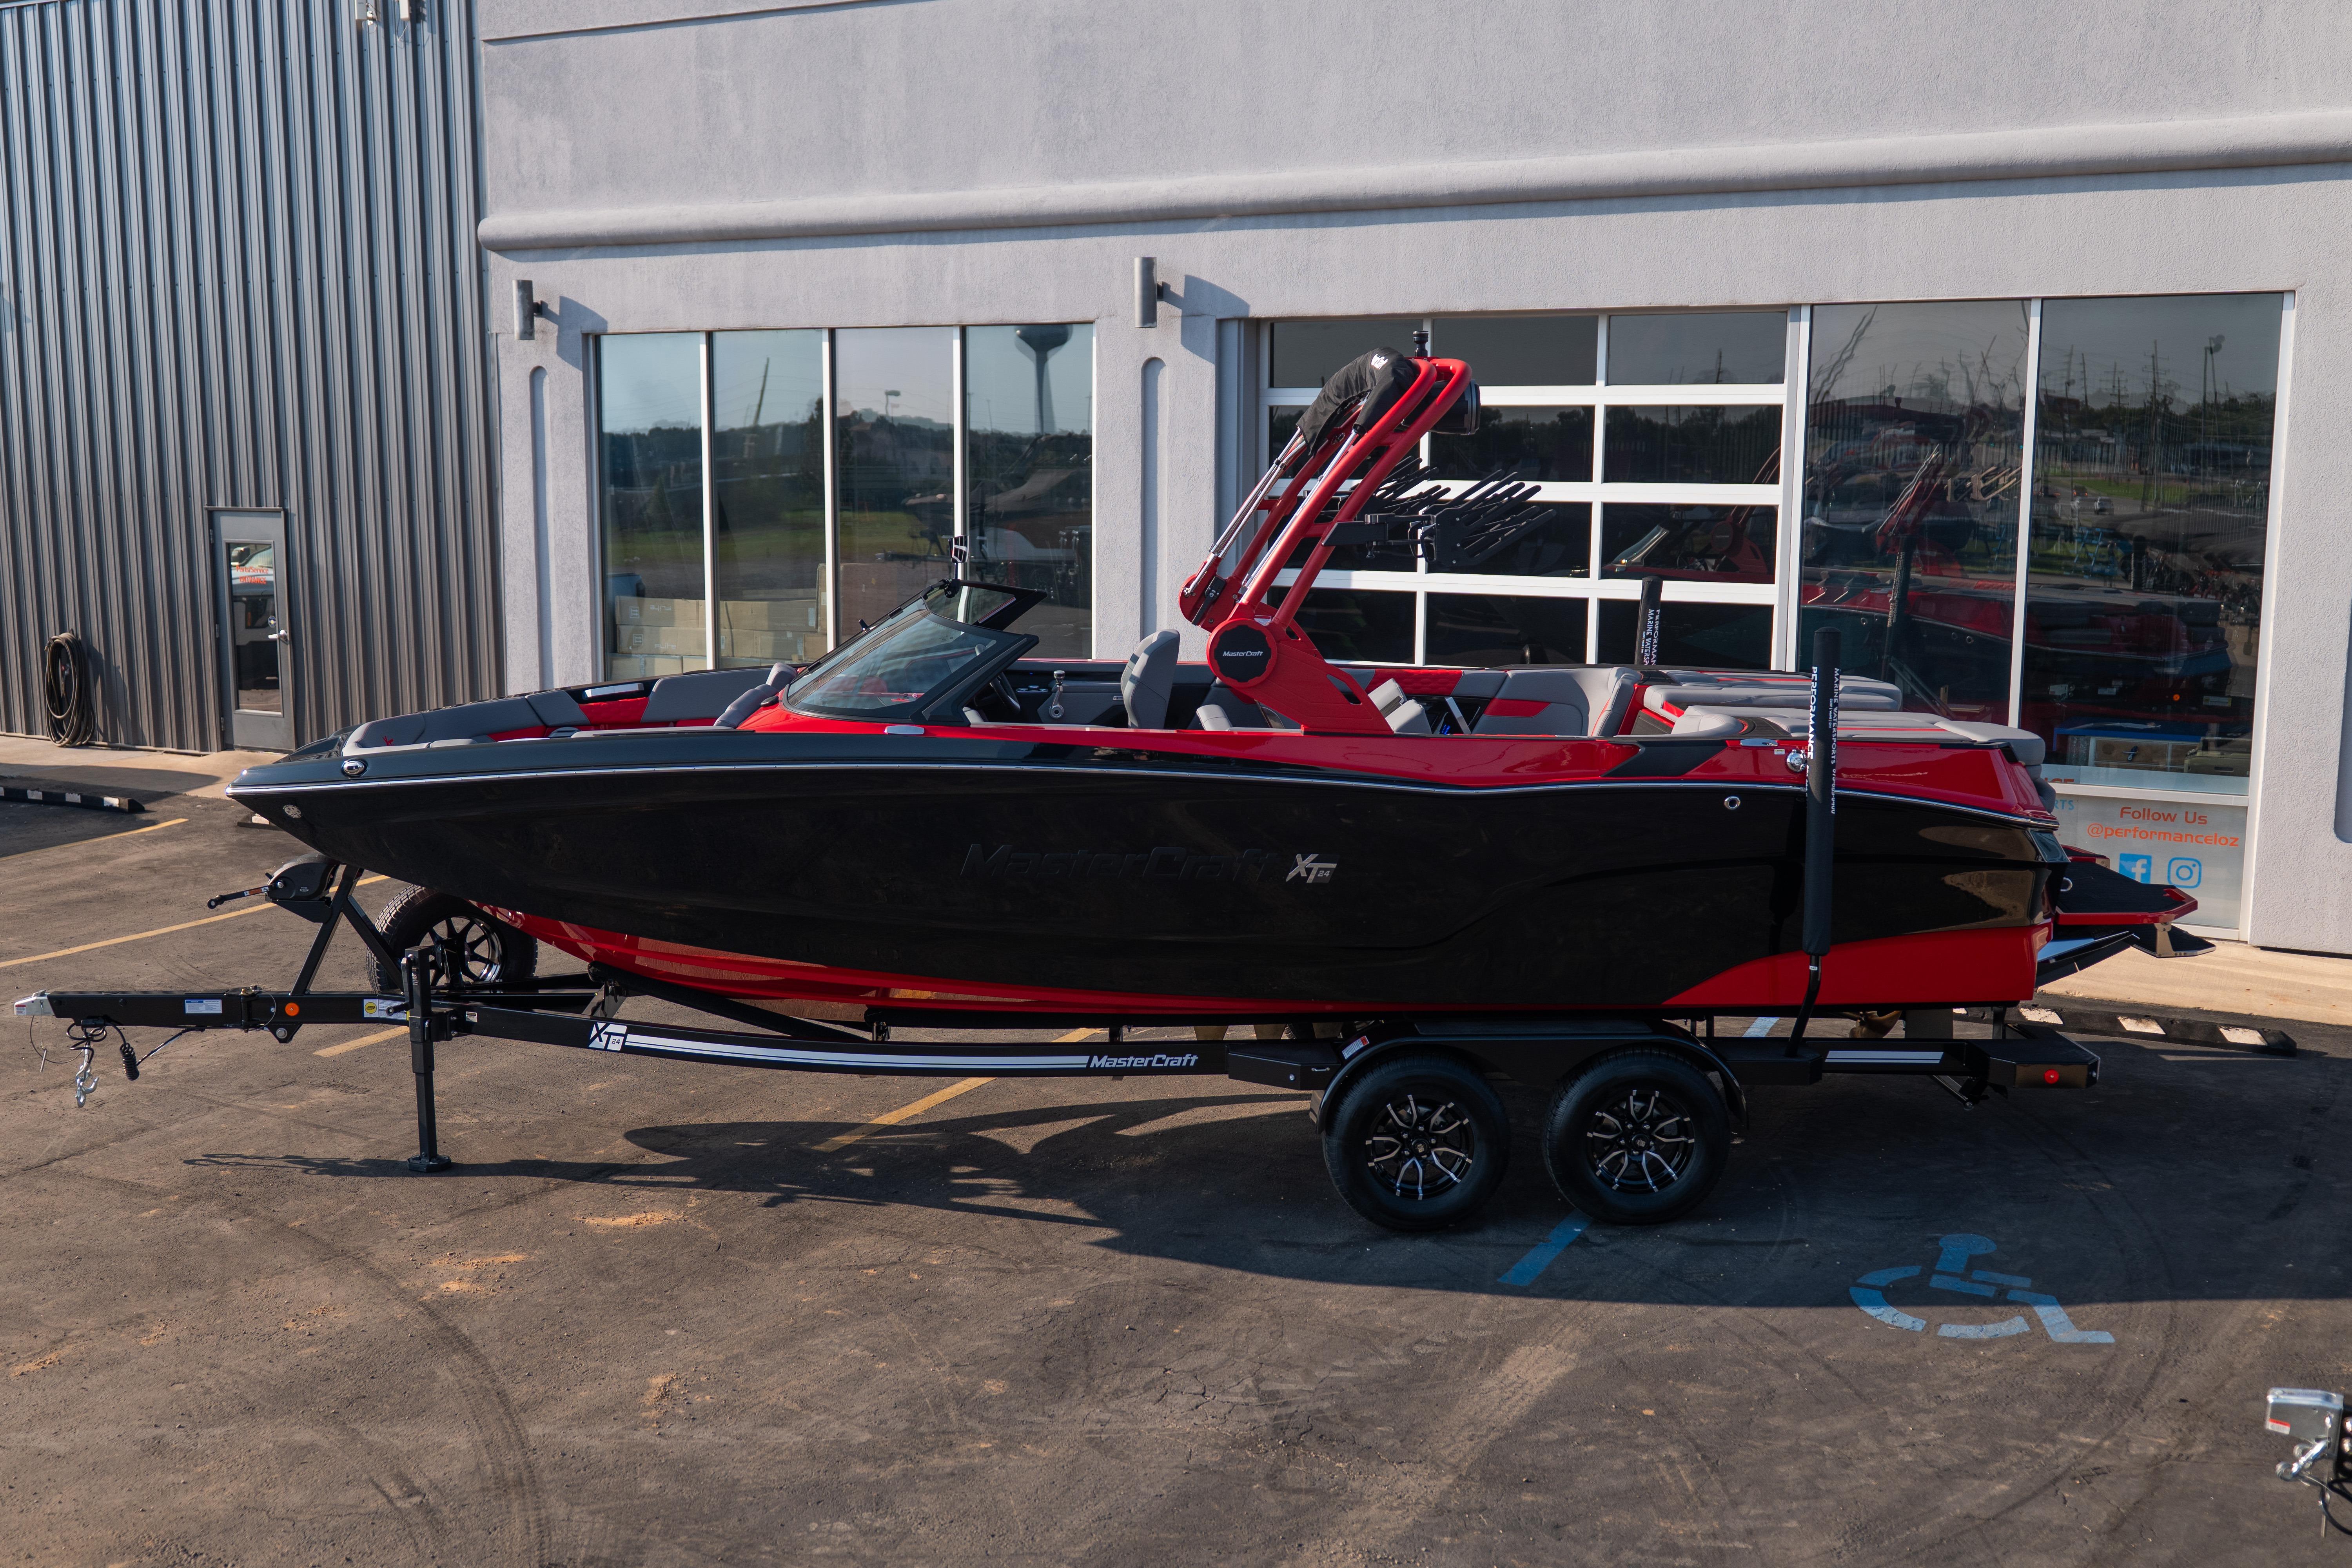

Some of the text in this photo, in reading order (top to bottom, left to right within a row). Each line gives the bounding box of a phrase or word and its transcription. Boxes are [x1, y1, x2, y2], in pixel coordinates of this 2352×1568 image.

[236, 564, 269, 574] Parts/Service
[240, 576, 267, 584] ENTRANCE
[1646, 609, 1655, 635] MARINE
[1651, 609, 1660, 665] PERFORMAN
[1643, 637, 1652, 665] WATERSP
[1808, 666, 1818, 759] PERFORMANCE
[1831, 706, 1839, 764] WATERSPORTS
[2120, 806, 2208, 825] Follow Us
[2087, 823, 2239, 847] @performanceloz
[960, 843, 1280, 882] MasterCraft
[1286, 853, 1338, 883] XT
[1089, 1054, 1198, 1068] MasterCraft
